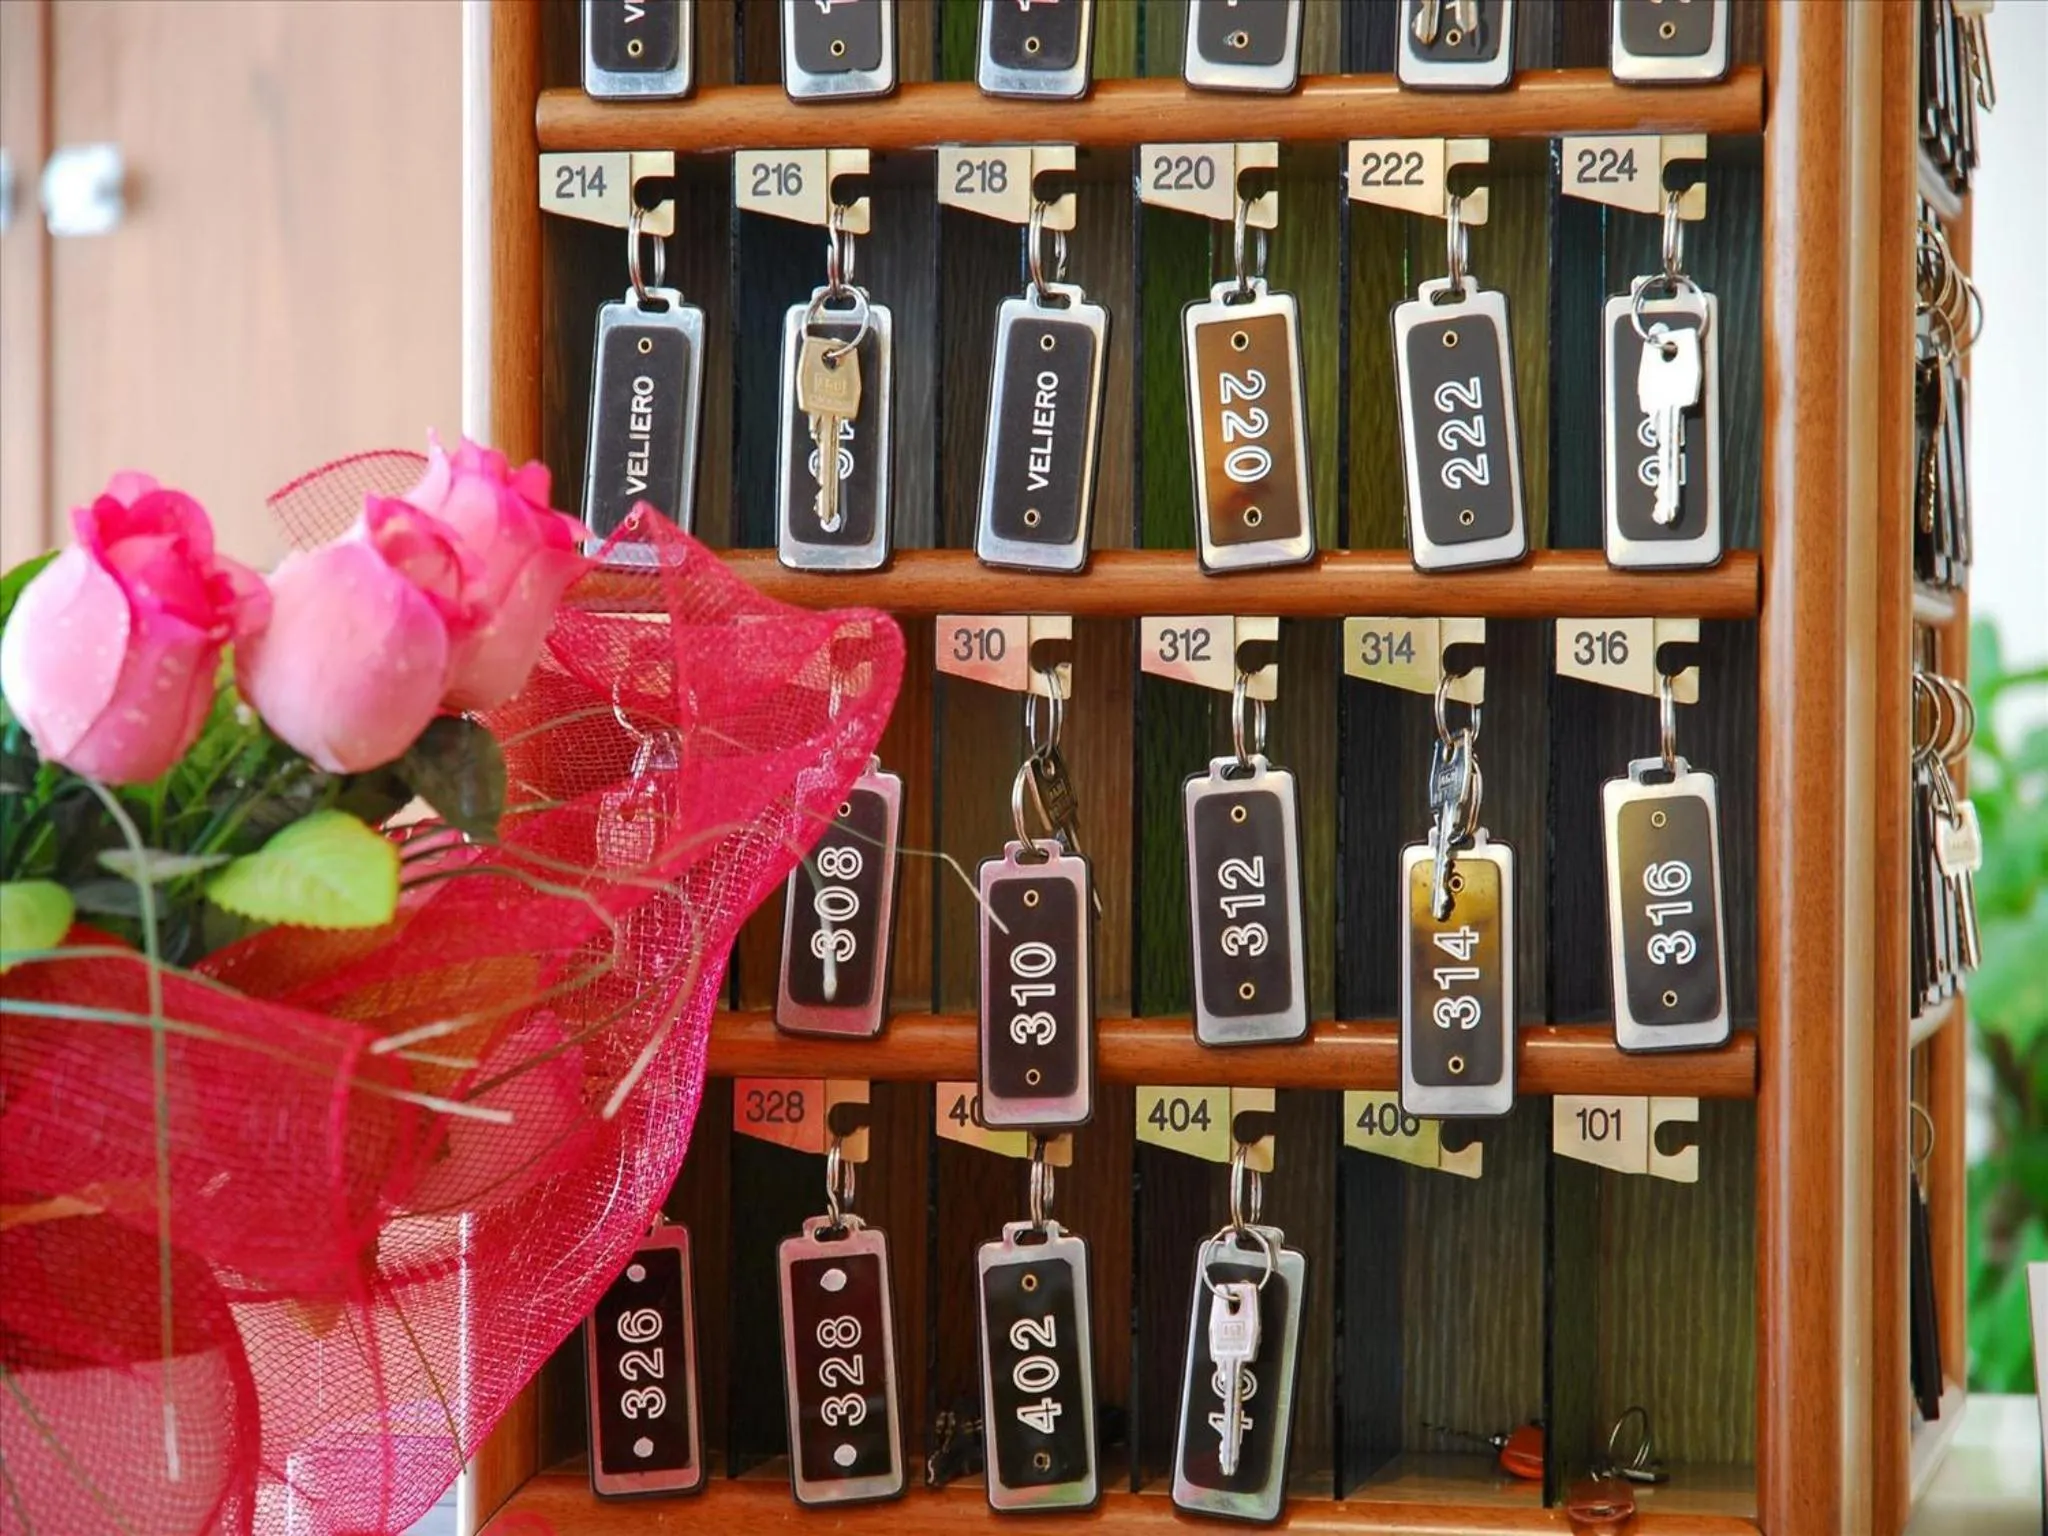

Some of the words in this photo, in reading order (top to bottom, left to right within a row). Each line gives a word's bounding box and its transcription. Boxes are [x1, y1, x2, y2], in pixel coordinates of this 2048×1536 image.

[556, 166, 607, 198] 214
[752, 163, 802, 196] 216
[955, 159, 1007, 193] 218
[1154, 156, 1214, 190] 220
[1362, 152, 1424, 186] 222
[1577, 148, 1637, 183] 224
[626, 376, 654, 495] VELIERO
[1027, 372, 1058, 490] VELIERO
[1220, 370, 1271, 482] 220
[1434, 377, 1489, 489] 222
[954, 628, 1005, 661] 310
[1159, 628, 1211, 662] 312
[1362, 632, 1416, 665] 314
[1574, 631, 1628, 665] 316
[811, 847, 862, 962] 308
[1218, 856, 1268, 956] 312
[1643, 861, 1696, 964] 316
[1010, 942, 1056, 1045] 310
[1433, 925, 1480, 1029] 314
[746, 1090, 804, 1123] 328
[1148, 1098, 1211, 1131] 404
[1576, 1108, 1620, 1141] 101
[618, 1309, 666, 1419] 326
[817, 1316, 866, 1426] 328
[1010, 1315, 1062, 1433] 402
[1208, 1368, 1257, 1445] 40
